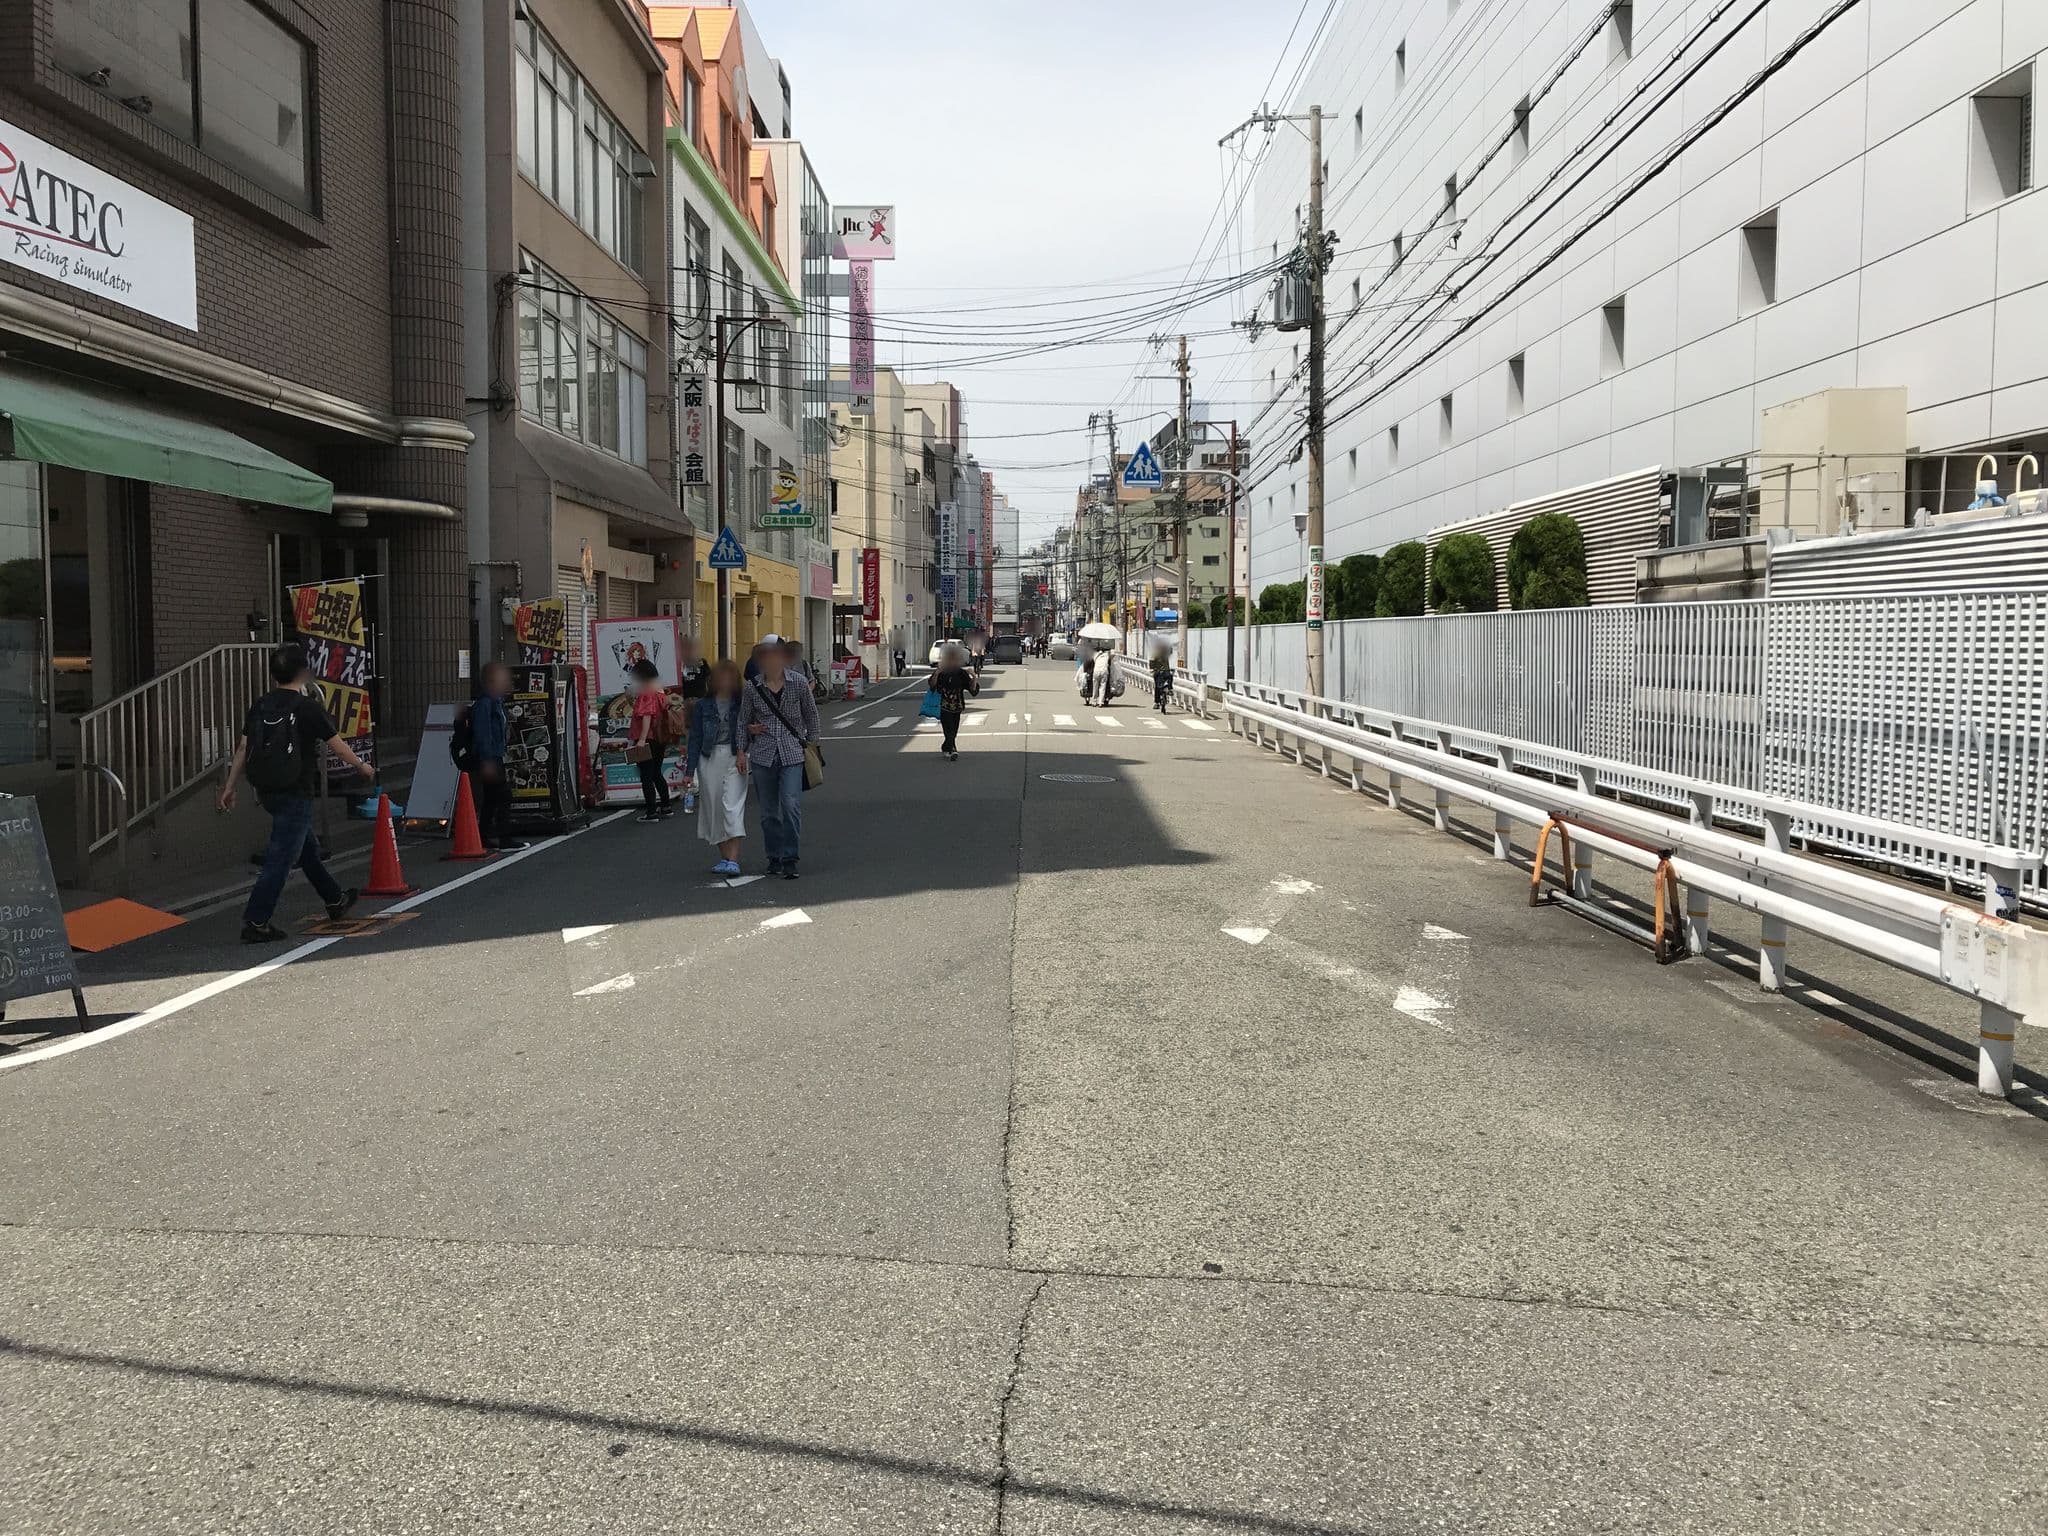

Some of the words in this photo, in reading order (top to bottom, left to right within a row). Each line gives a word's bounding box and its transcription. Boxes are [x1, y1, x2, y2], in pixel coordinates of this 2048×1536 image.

[837, 216, 865, 236] Jhc
[14, 231, 68, 278] Racing
[73, 257, 133, 293] simulator
[854, 265, 870, 385] お菓子の材料と器具
[852, 395, 870, 407] Jhc
[864, 629, 878, 637] 24
[319, 683, 372, 737] AFE
